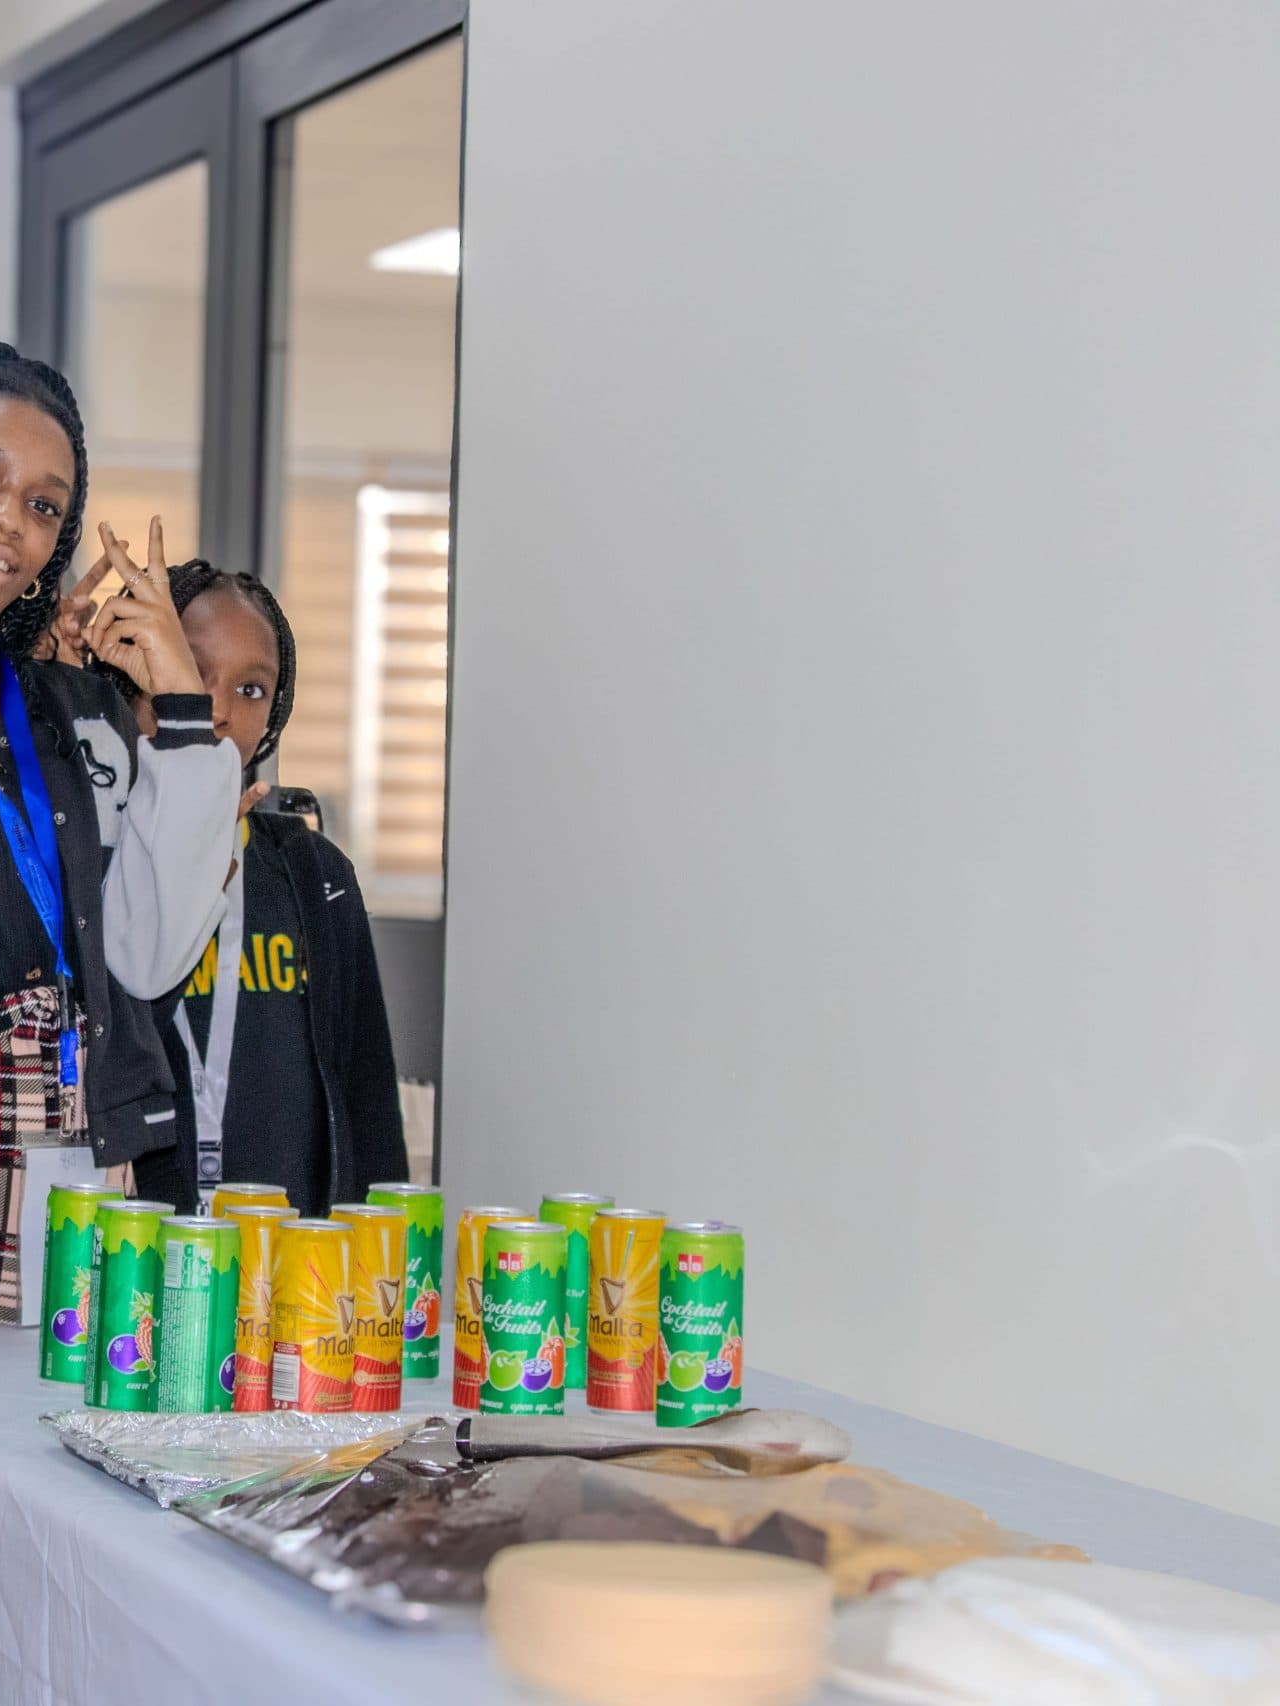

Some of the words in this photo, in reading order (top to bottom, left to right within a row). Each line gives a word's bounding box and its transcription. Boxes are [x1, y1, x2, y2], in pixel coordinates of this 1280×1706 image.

[483, 1294, 547, 1317] Cocktail
[660, 1296, 728, 1319] Cocktail
[491, 1314, 542, 1335] Fruits
[589, 1313, 644, 1338] Malta
[672, 1315, 724, 1337] Fruits
